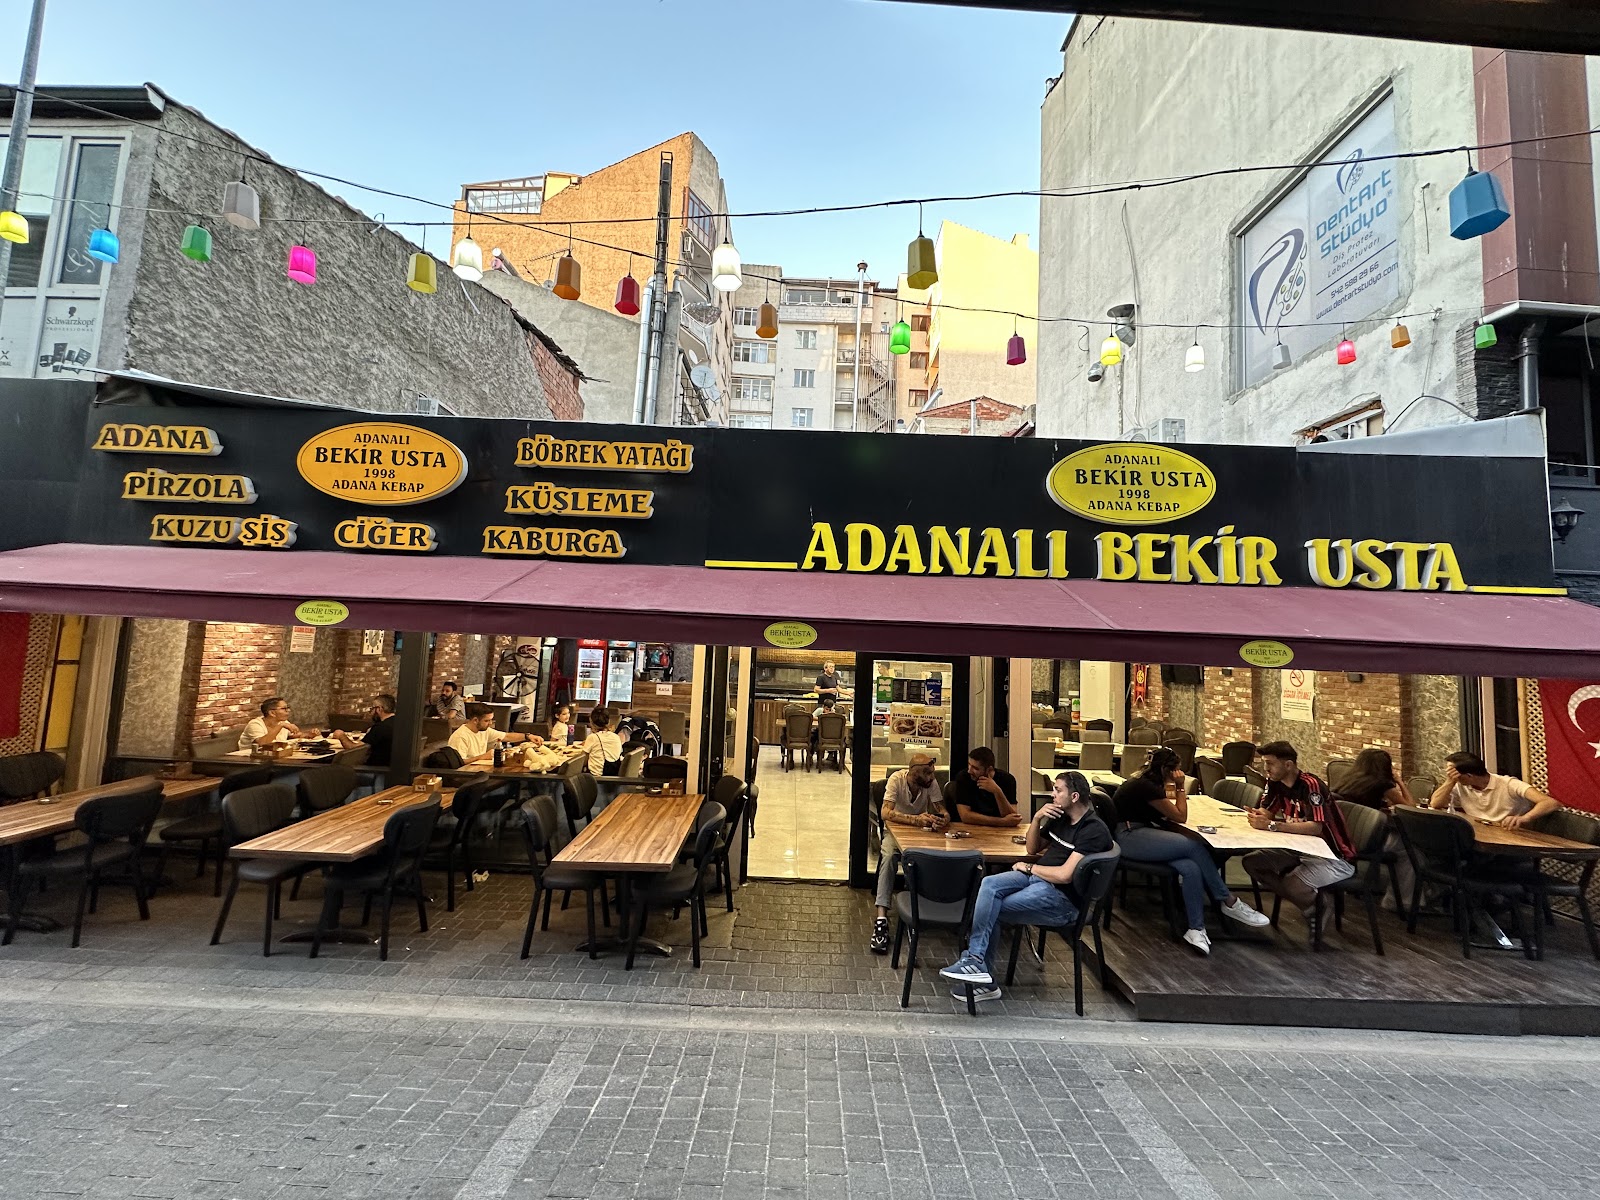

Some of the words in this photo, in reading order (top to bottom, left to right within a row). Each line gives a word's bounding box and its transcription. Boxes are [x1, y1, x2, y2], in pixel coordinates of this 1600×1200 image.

[1347, 231, 1373, 254] Protez
[1316, 261, 1399, 320] www.dentartstudyo.com
[1331, 285, 1344, 299] 542
[46, 316, 96, 328] Schwarzkopf
[100, 427, 209, 450] ADANA
[354, 433, 410, 445] ADANALI
[315, 444, 382, 467] BEKİR
[391, 450, 447, 468] USTA
[521, 437, 607, 464] BÖBREK
[614, 443, 687, 467] YATAĞI
[1104, 454, 1161, 466] ADANALI
[128, 471, 245, 499] PİRZOLA
[363, 468, 396, 479] 1998
[1075, 465, 1143, 486] BEKİR
[1151, 471, 1207, 488] USTA
[332, 479, 377, 492] ADANA
[381, 481, 424, 493] KEBAP
[1118, 489, 1150, 499] 1998
[510, 485, 647, 514] KÜŞLEME
[1088, 501, 1133, 511] ADANA
[1137, 502, 1180, 512] KEBAP
[156, 518, 232, 540] KUZU
[241, 517, 287, 546] ŞİŞ
[339, 519, 428, 547] CİĞER
[487, 529, 619, 554] KABURGA
[801, 522, 1069, 578] ADANALI
[1094, 525, 1283, 586] BEKİR
[1304, 538, 1468, 592] USTA
[301, 606, 323, 615] BEKİR
[324, 608, 343, 616] USTA
[770, 629, 791, 637] BEKİR
[792, 630, 812, 638] USTA
[1245, 648, 1268, 656] BEKİR
[1269, 649, 1288, 657] USTA
